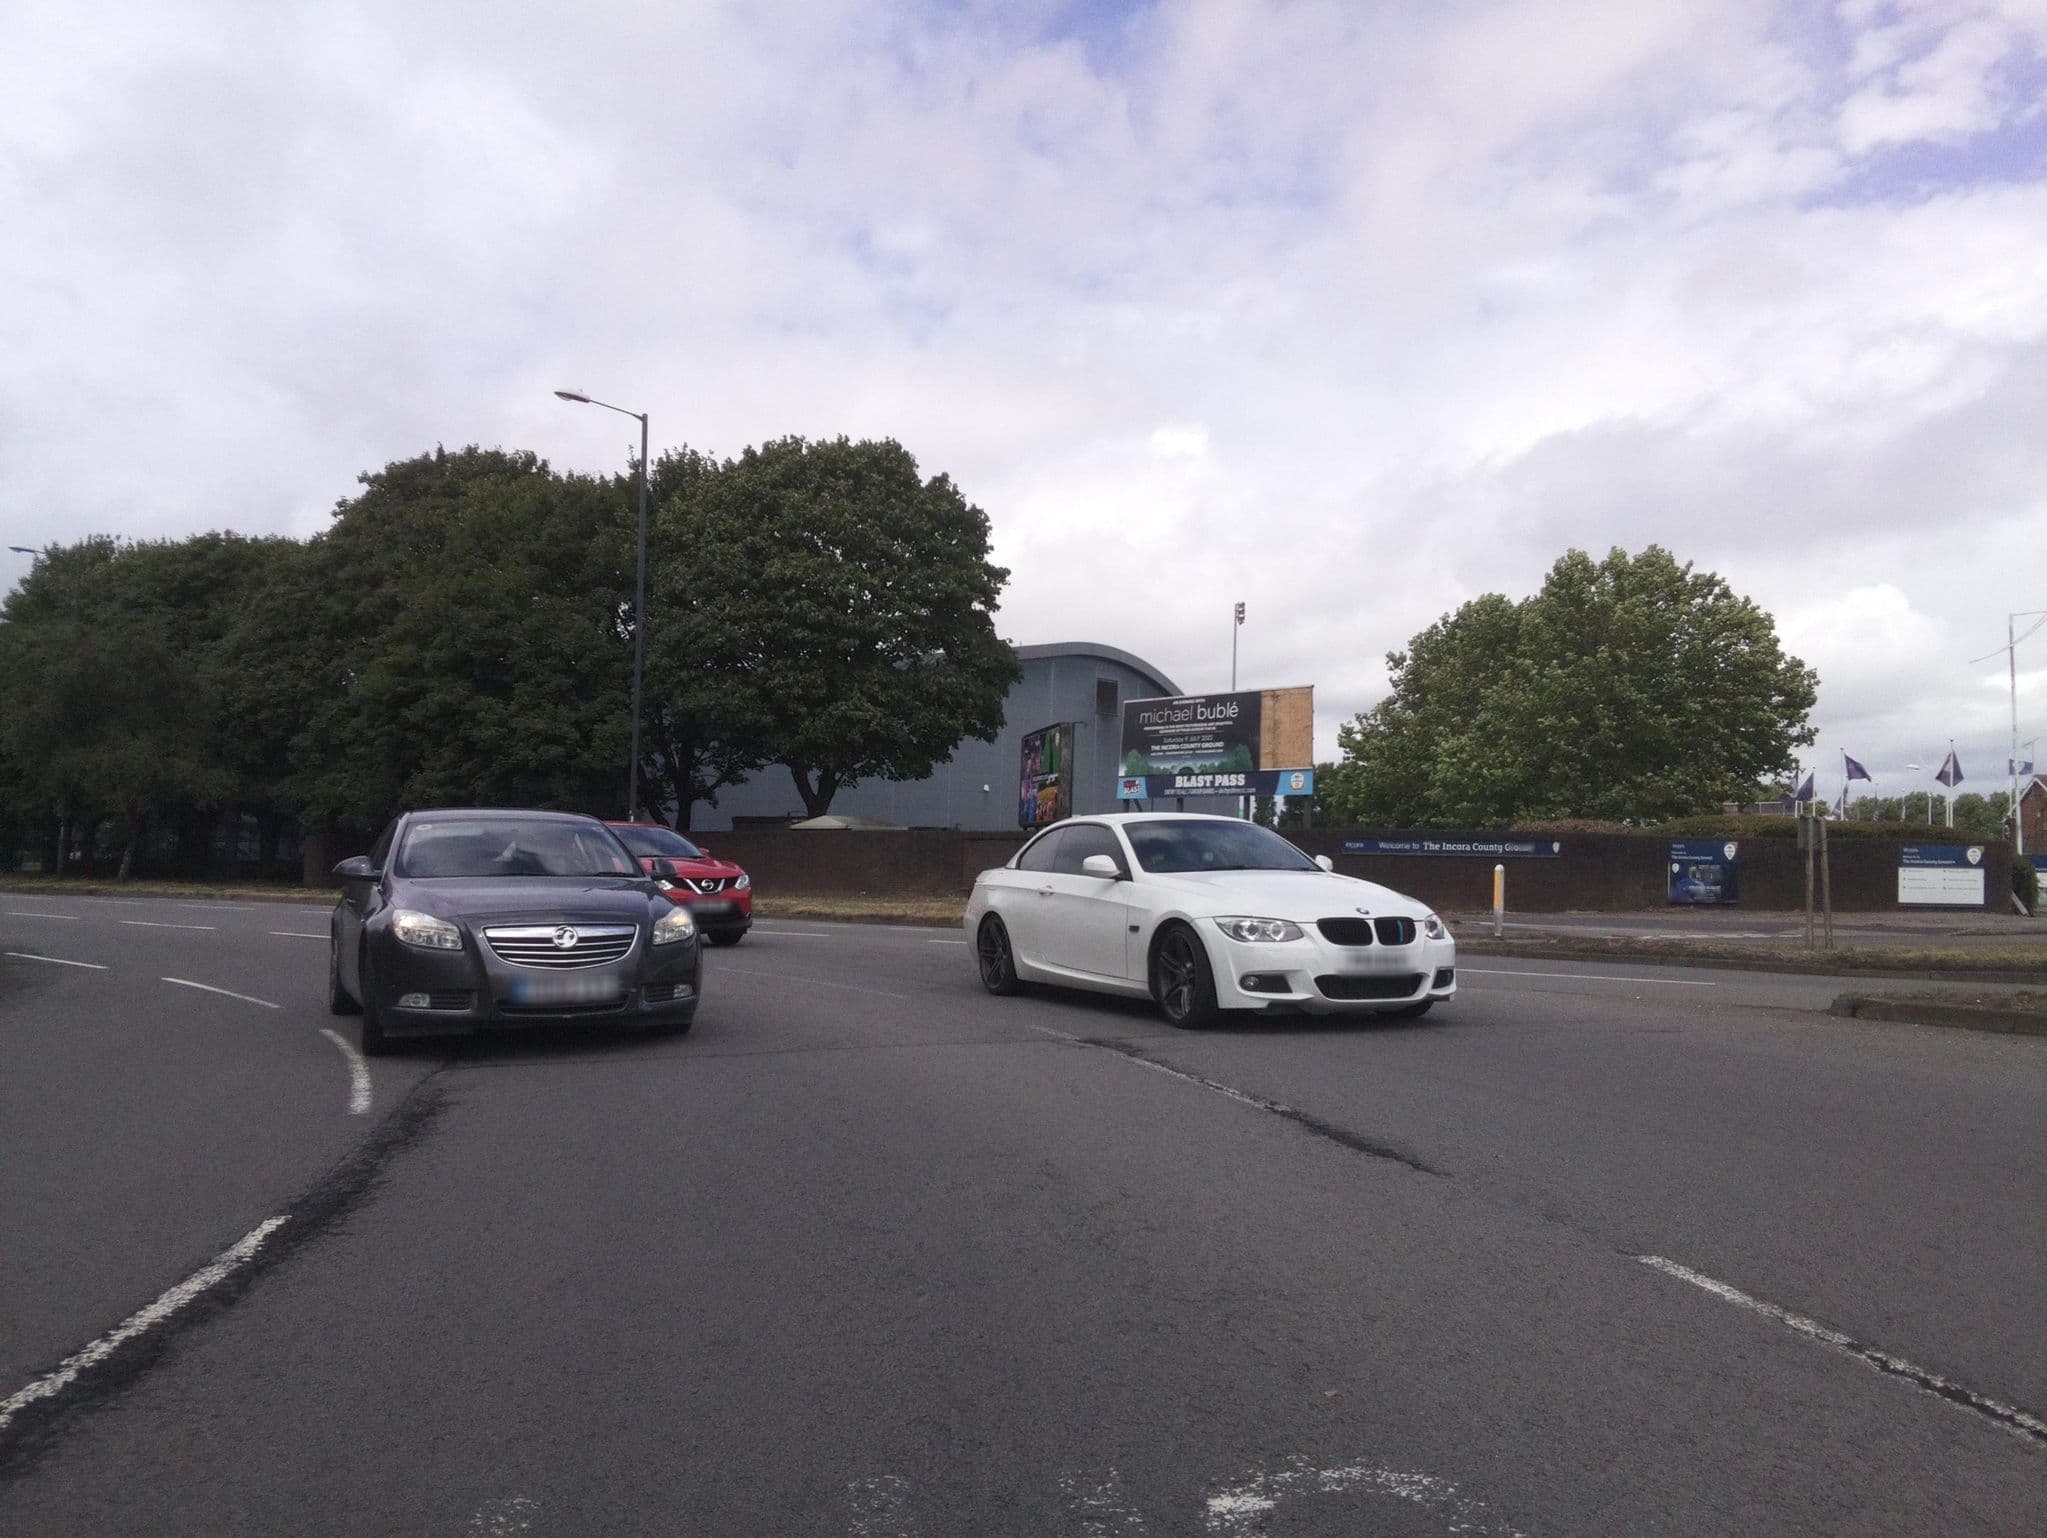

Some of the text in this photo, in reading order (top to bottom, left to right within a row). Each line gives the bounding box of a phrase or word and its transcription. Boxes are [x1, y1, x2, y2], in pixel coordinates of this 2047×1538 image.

[1139, 701, 1239, 723] michael bublé
[1175, 774, 1246, 787] BLAST PASS
[1379, 842, 1411, 850] Welcome
[1422, 841, 1440, 850] The
[1442, 842, 1471, 851] Incora
[1472, 842, 1503, 853] County
